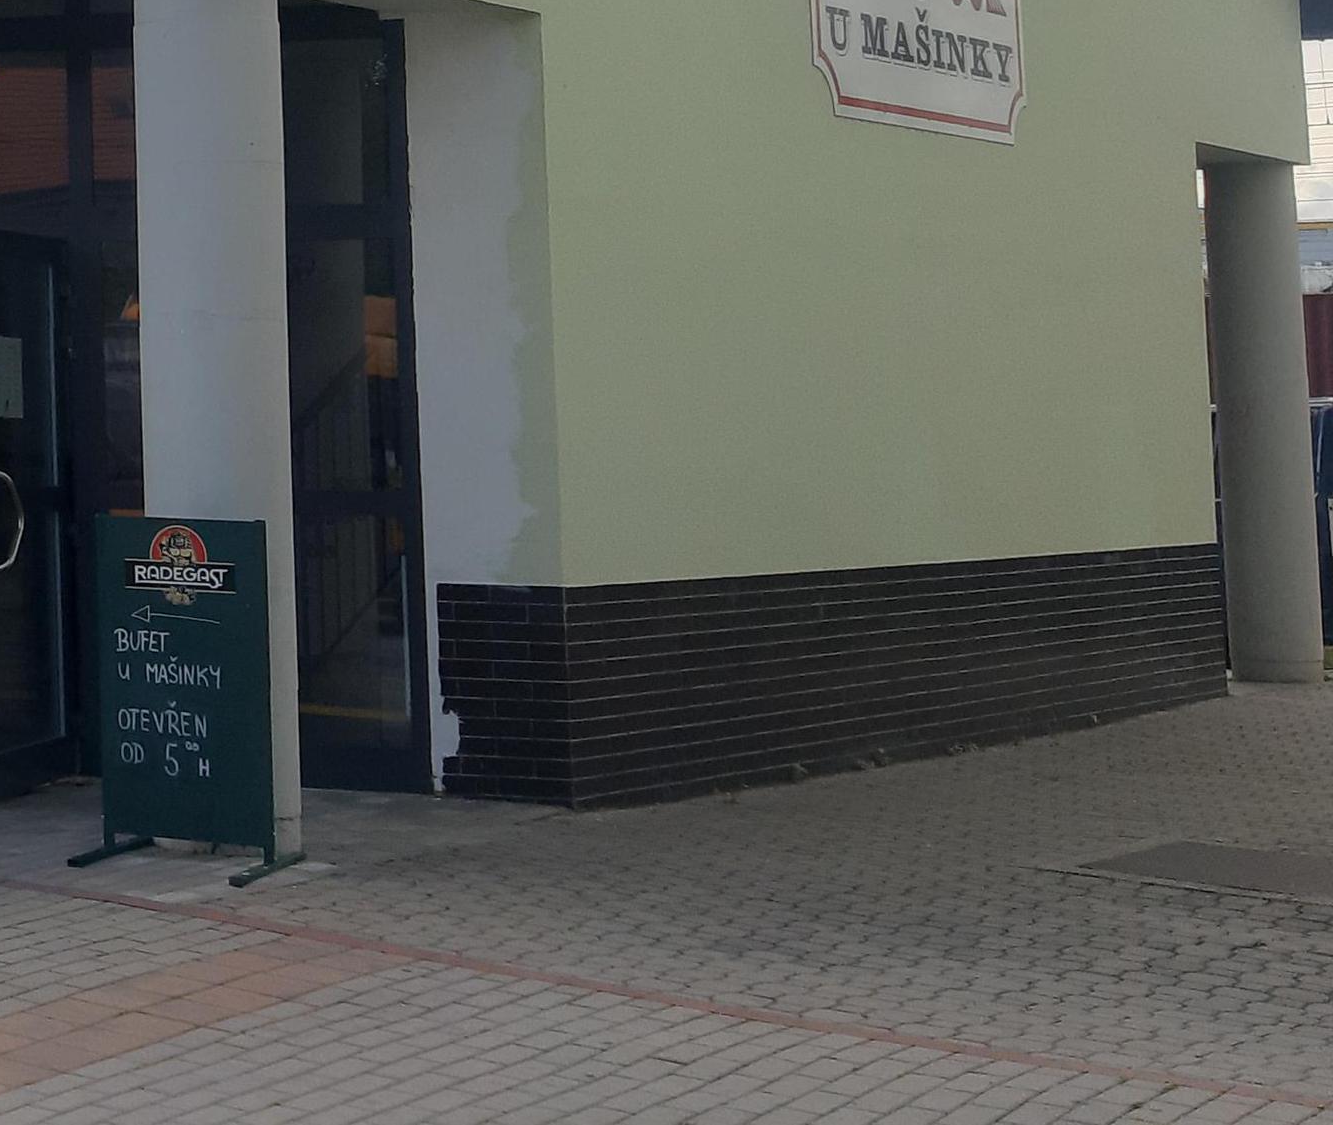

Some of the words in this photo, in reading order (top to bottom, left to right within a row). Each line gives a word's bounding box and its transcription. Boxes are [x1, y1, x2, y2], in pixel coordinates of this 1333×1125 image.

[826, 5, 850, 52] U
[861, 7, 1014, 85] MAŠINKY
[134, 565, 229, 588] RADEGAST
[114, 628, 171, 653] BUFET
[145, 656, 222, 690] MAŠINKY
[117, 701, 208, 738] OTEVŘEN
[121, 742, 145, 765] OD
[198, 758, 211, 777] H
